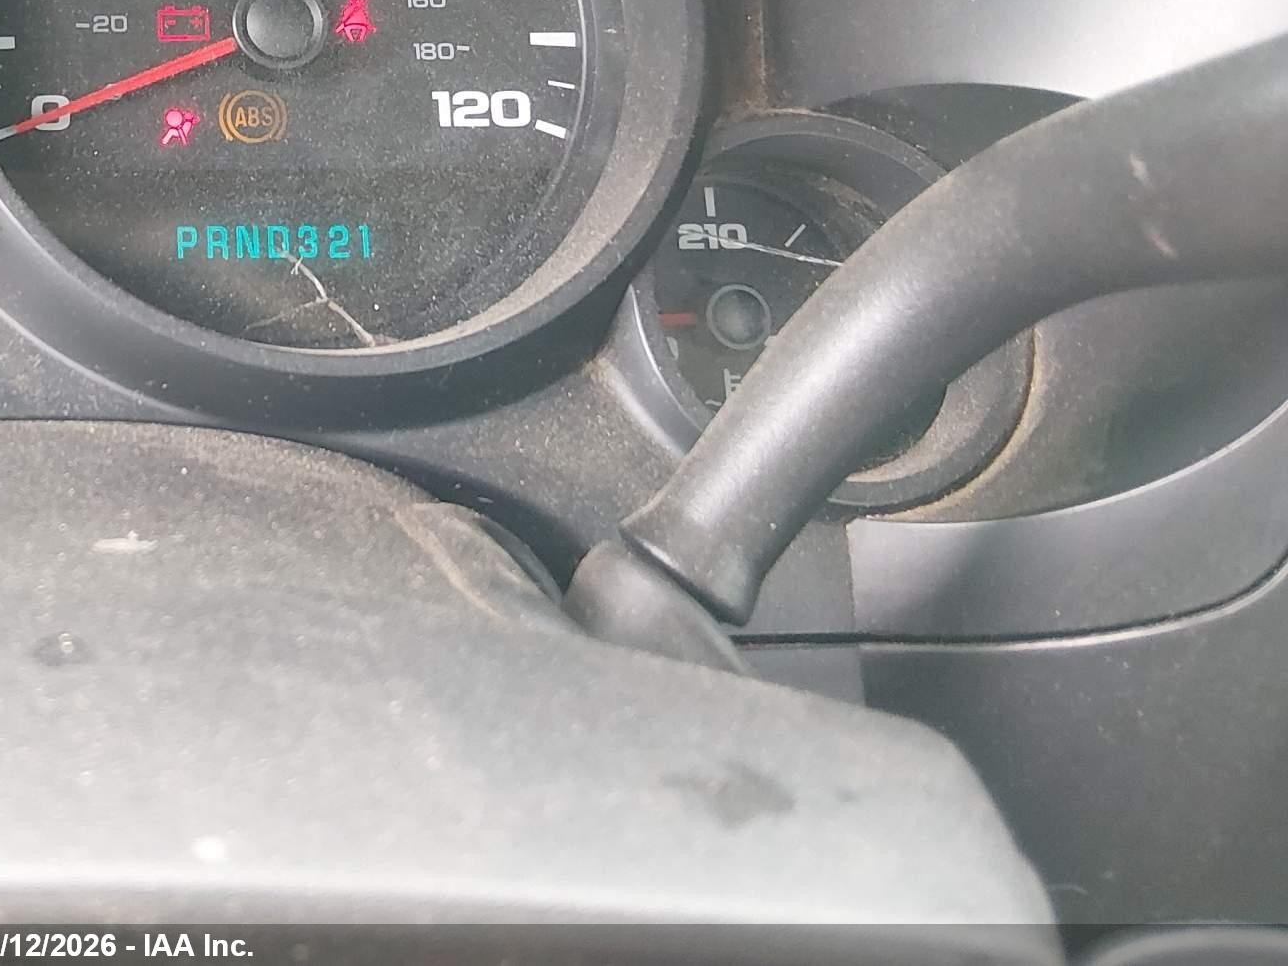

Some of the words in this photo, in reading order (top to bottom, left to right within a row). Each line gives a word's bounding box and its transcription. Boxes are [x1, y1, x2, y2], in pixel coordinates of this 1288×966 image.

[93, 15, 128, 33] 20
[413, 42, 455, 60] 180
[31, 94, 71, 131] 0
[235, 107, 275, 127] ABS
[431, 90, 531, 128] 120
[678, 223, 748, 250] 210
